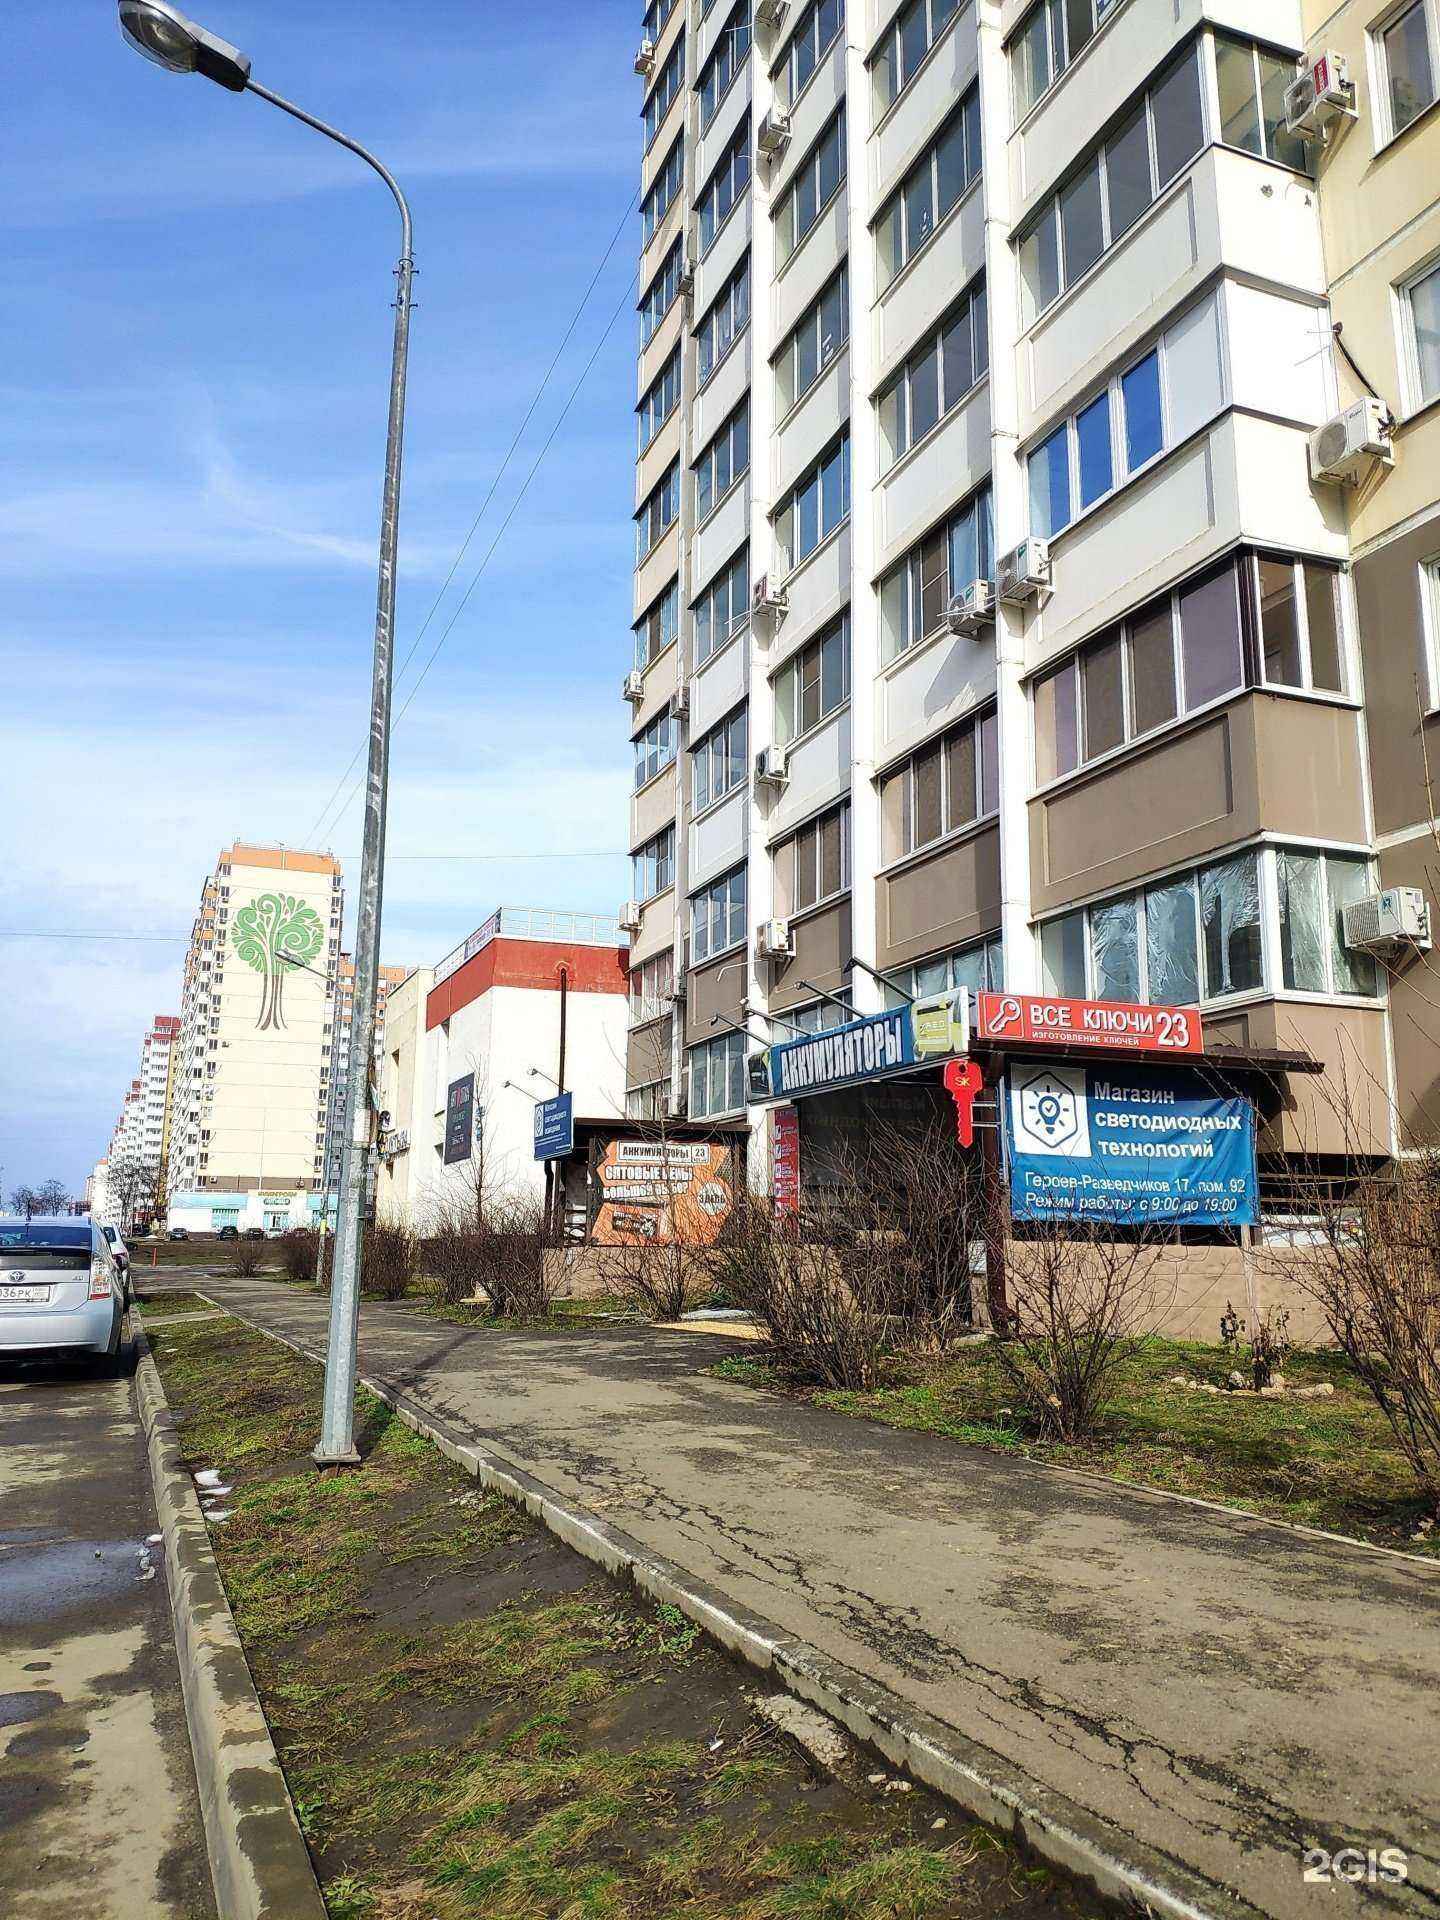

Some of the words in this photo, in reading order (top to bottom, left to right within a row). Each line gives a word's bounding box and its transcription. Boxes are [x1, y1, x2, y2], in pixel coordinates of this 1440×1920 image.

[1030, 1004, 1072, 1028] ВСЕ
[1083, 1008, 1154, 1034] КЛЮЧИ
[1156, 1011, 1190, 1048] 23
[1032, 1031, 1101, 1043] ИЗГОТОВЛЕНИЕ
[1103, 1036, 1140, 1047] КЛЮЧЕЙ
[781, 1017, 903, 1091] АККУМУЛЯТОРЫ
[1094, 1081, 1175, 1105] Магазин
[1095, 1112, 1242, 1133] светодиодных
[1098, 1138, 1214, 1158] технологий
[1229, 1179, 1246, 1193] 92
